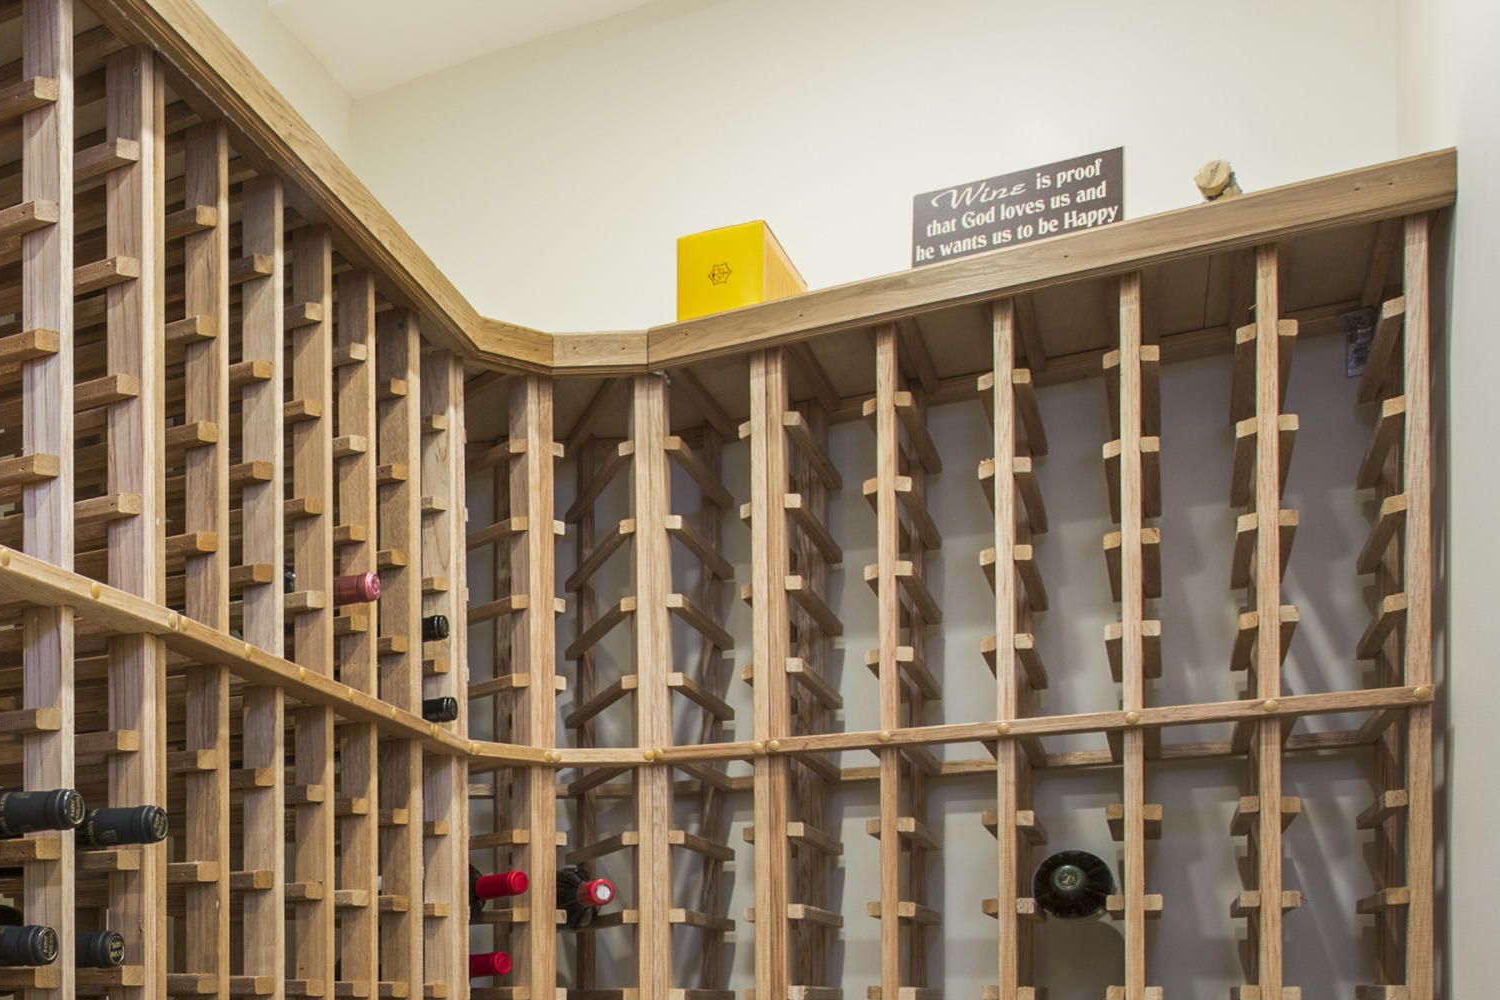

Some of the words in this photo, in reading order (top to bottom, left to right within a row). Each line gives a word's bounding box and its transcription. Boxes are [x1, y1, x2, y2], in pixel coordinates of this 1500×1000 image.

[926, 217, 957, 237] that
[961, 207, 995, 229] God
[1000, 198, 1045, 221] loves
[1050, 192, 1071, 209] us
[1076, 180, 1107, 204] and
[931, 182, 1026, 209] Wine
[1036, 172, 1051, 190] is
[1056, 158, 1103, 188] proof
[915, 245, 934, 262] he
[939, 231, 987, 257] wants
[992, 229, 1012, 246] us
[1017, 223, 1033, 240] to
[1038, 217, 1059, 235] be
[1063, 204, 1118, 230] Happy
